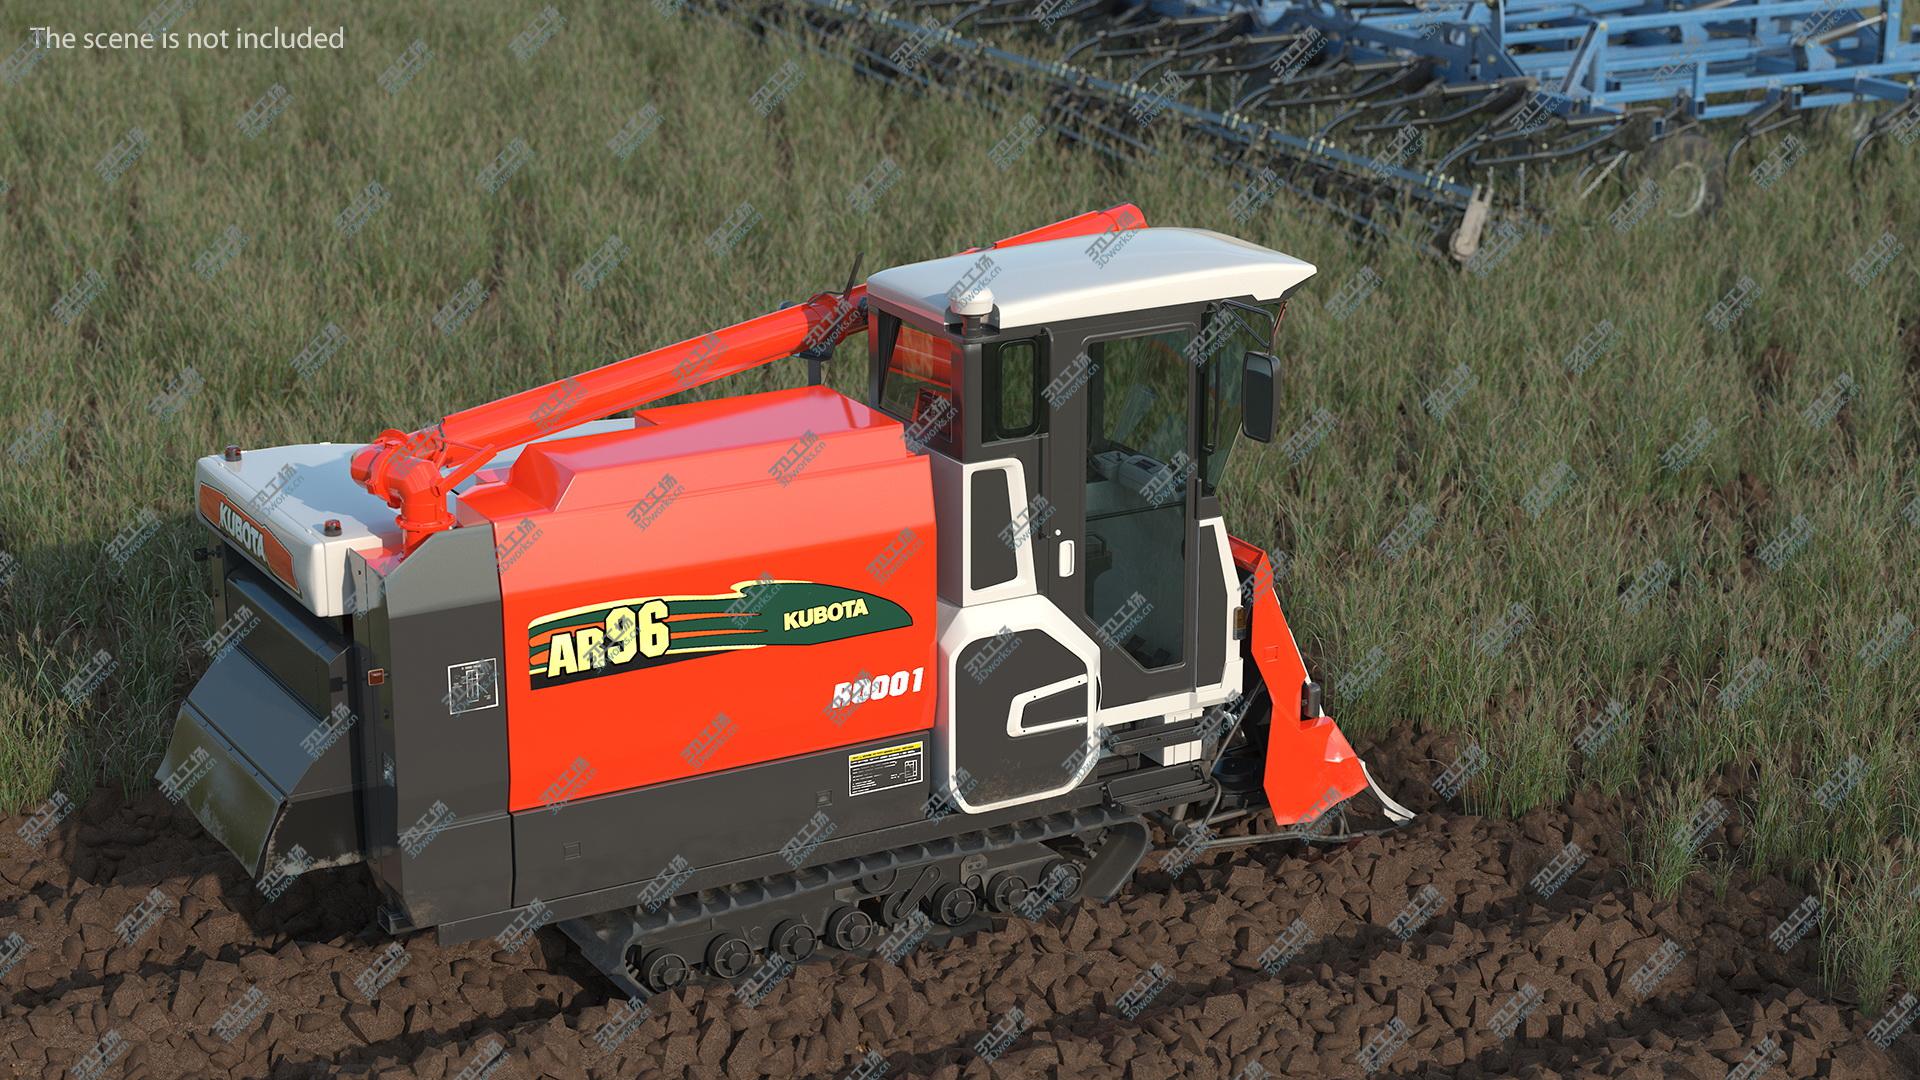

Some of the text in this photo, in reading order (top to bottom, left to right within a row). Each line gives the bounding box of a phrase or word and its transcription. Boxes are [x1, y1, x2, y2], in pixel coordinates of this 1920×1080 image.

[219, 500, 267, 562] KUBOTA
[547, 598, 670, 678] AR96
[783, 597, 870, 632] KUBOTA
